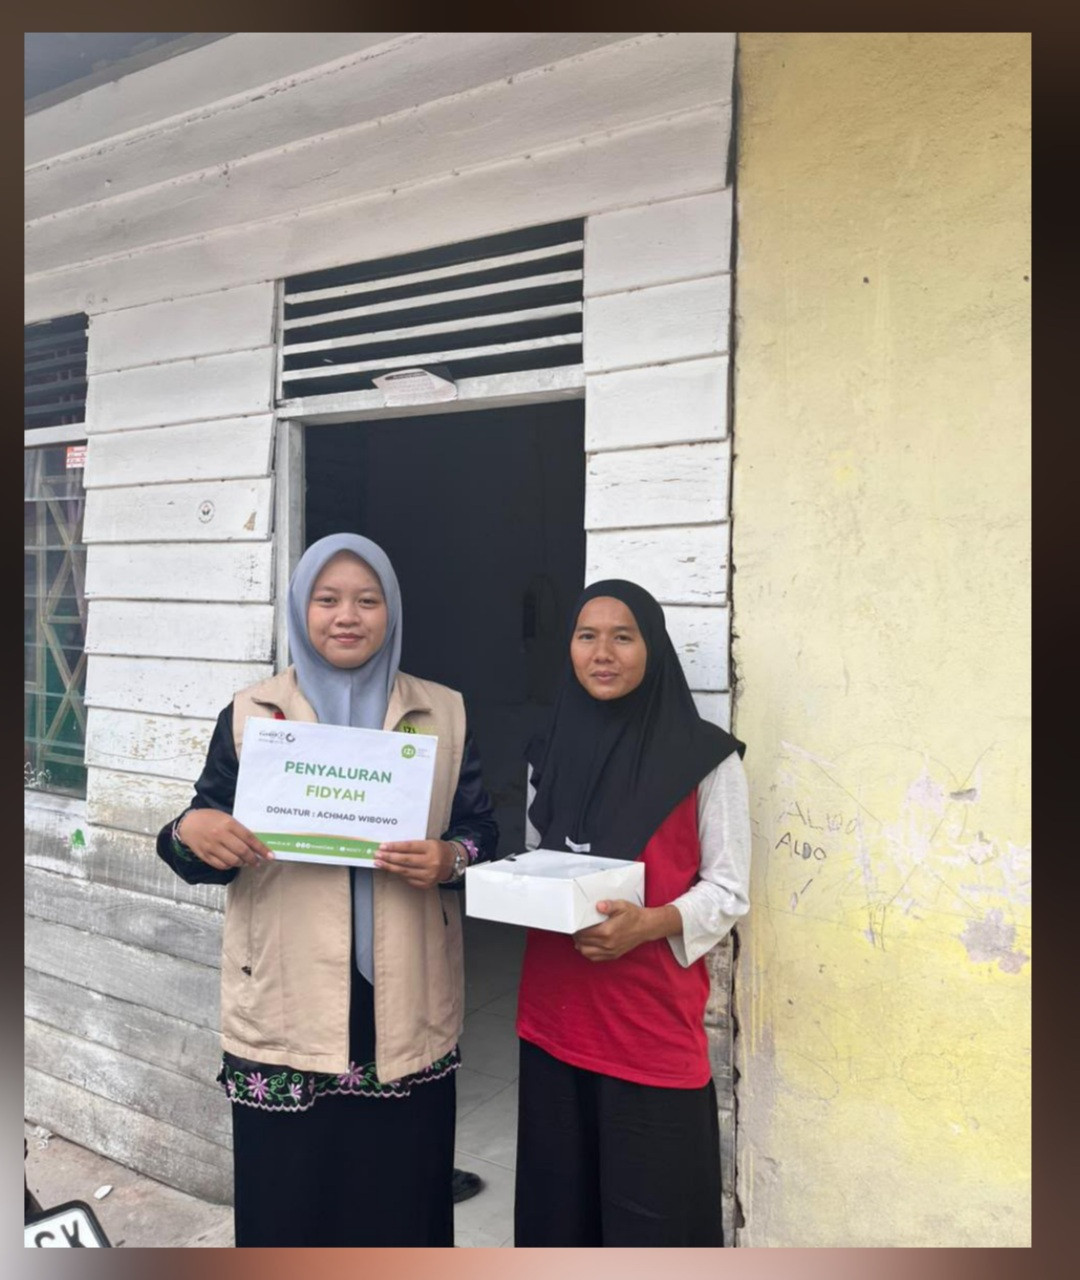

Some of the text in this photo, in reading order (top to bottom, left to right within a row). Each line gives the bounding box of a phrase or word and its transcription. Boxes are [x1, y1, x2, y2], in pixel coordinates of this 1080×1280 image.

[284, 761, 392, 783] PENYALURAN
[305, 785, 366, 802] FIDYAH
[266, 806, 311, 817] DONATUR
[316, 811, 356, 821] ACHMAD
[358, 815, 398, 825] WIBOWO
